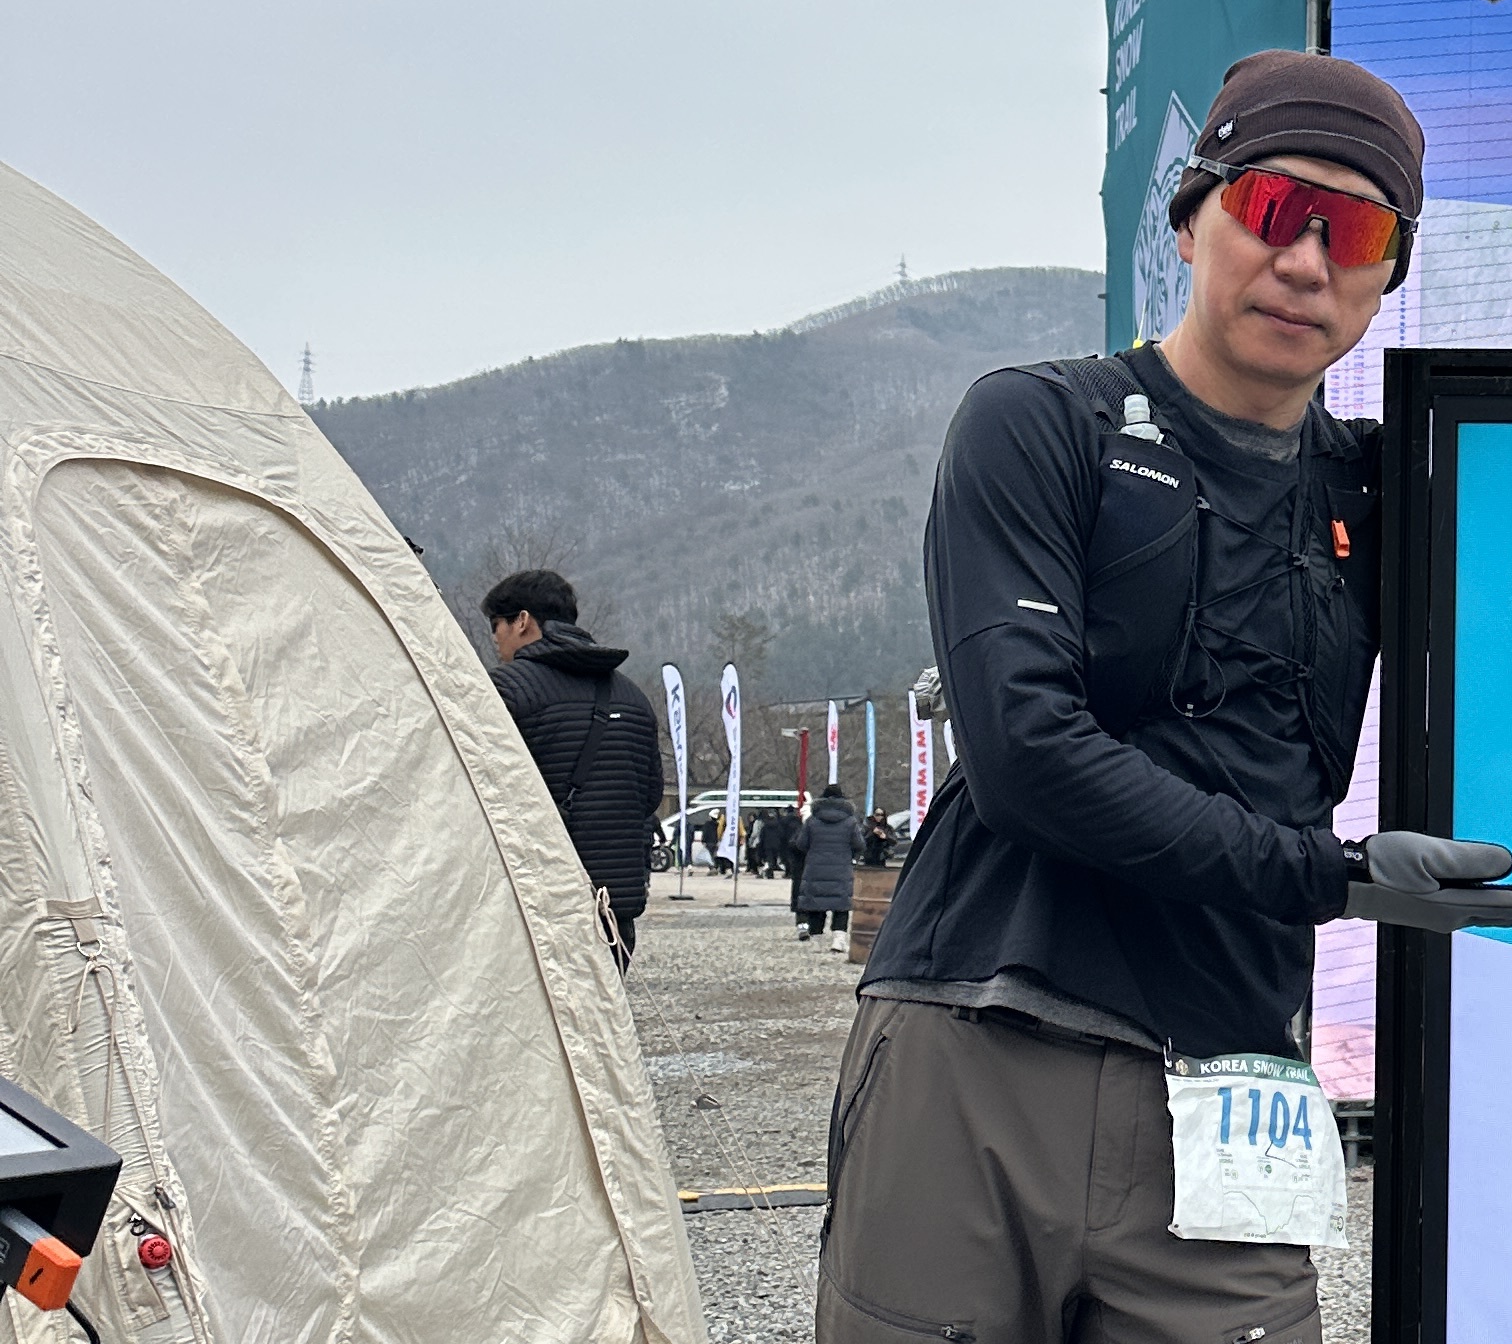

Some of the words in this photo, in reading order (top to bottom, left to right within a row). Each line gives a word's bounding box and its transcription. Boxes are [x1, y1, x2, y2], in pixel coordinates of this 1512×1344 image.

[1110, 459, 1180, 488] SALOMON
[1200, 1059, 1248, 1075] KOREA
[1253, 1061, 1286, 1077] SNOW
[1286, 1066, 1310, 1082] TRAIL
[1217, 1087, 1312, 1150] 1104
